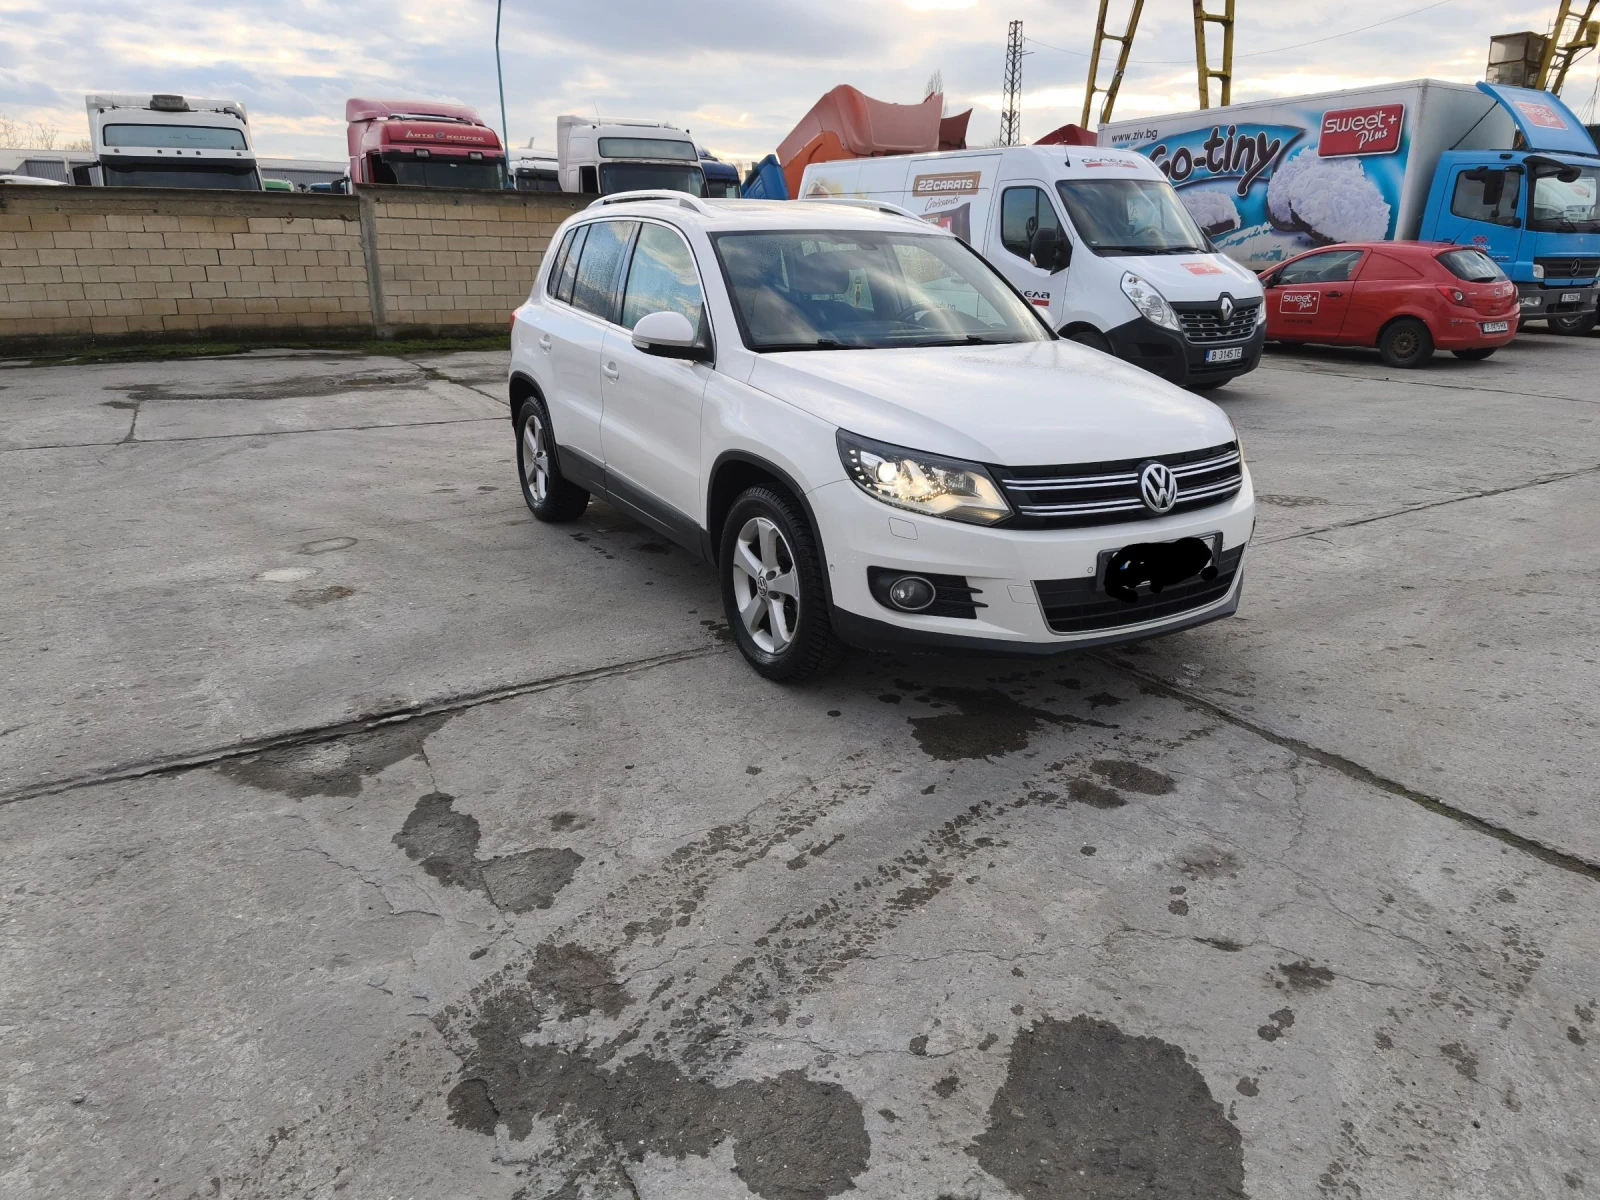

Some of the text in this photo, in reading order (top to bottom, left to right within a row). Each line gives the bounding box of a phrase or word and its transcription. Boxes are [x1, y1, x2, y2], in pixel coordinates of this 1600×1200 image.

[1324, 111, 1386, 133] sweet
[1111, 128, 1158, 142] www.ziv.bg
[917, 179, 974, 191] 22CARATS
[1283, 294, 1311, 303] sweet
